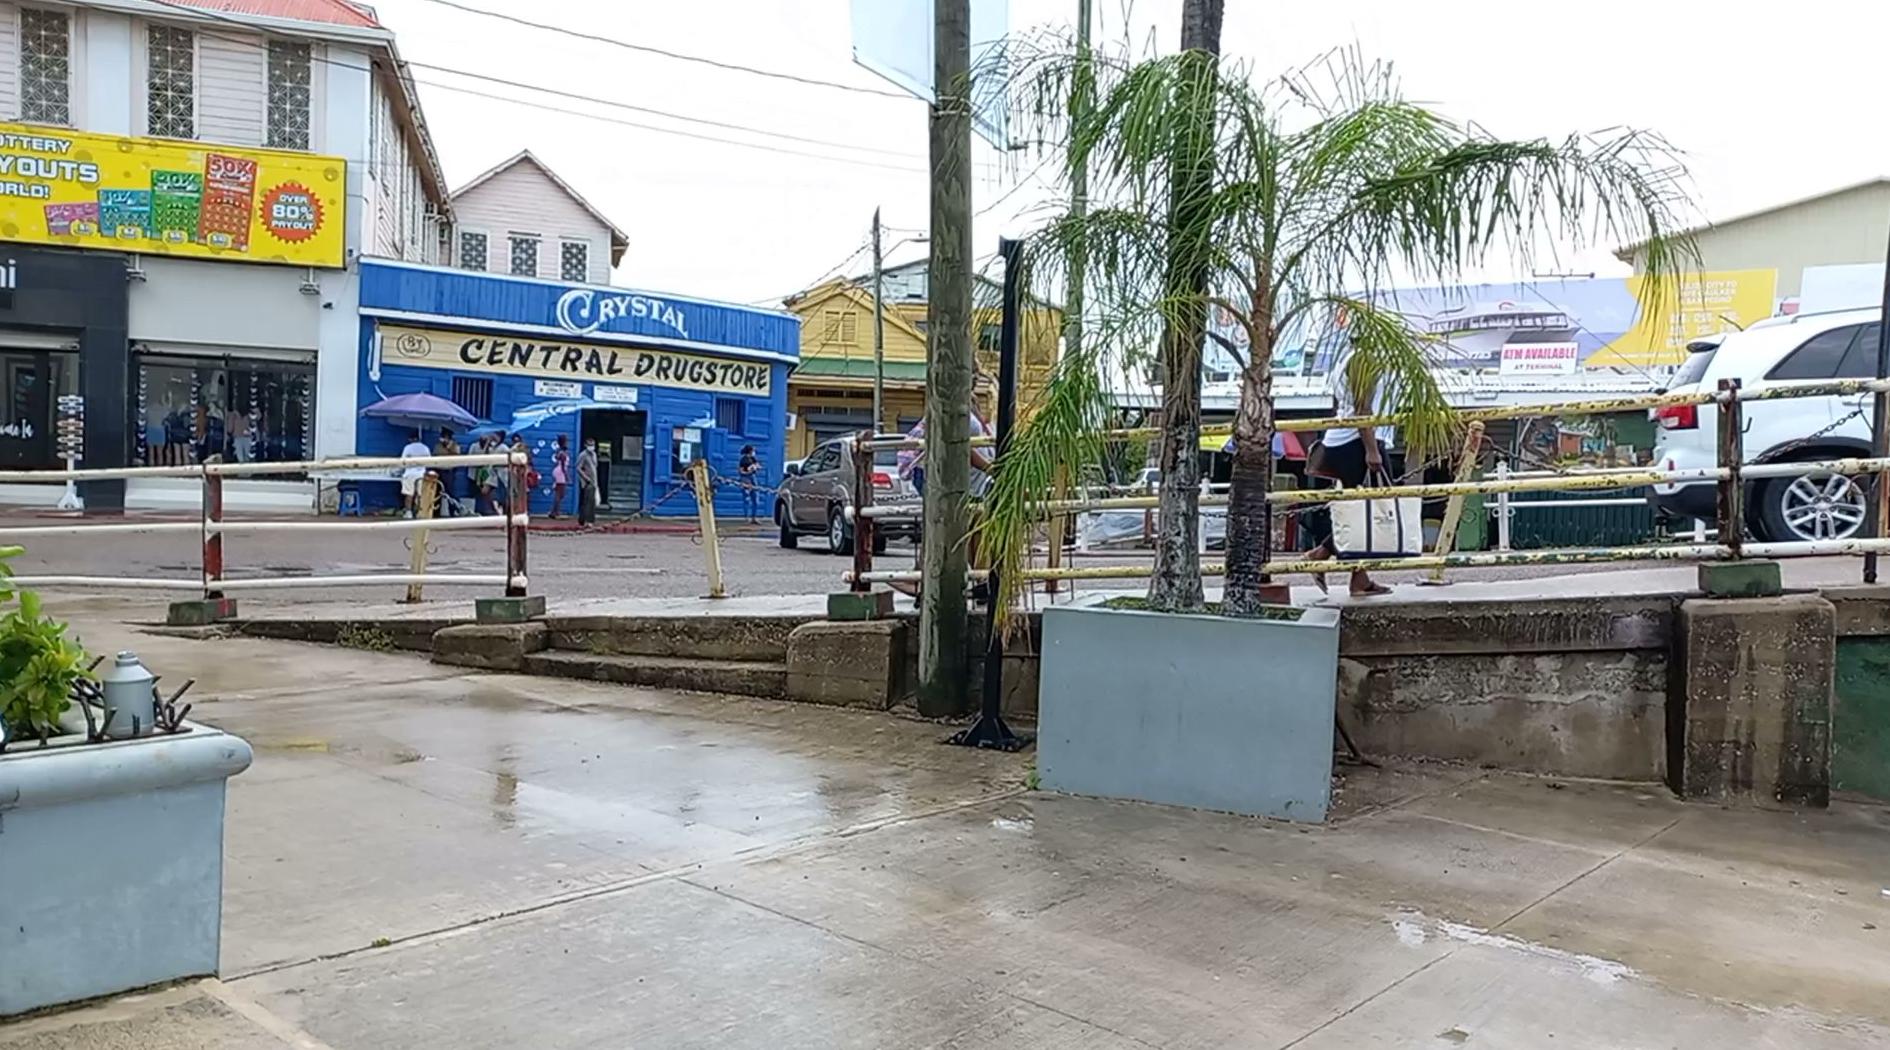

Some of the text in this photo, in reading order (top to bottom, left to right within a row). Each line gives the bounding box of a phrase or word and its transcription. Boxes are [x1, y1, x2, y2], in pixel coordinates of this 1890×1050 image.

[279, 194, 308, 203] OVER
[272, 204, 314, 220] 80%
[271, 220, 315, 230] PAYOUT
[555, 289, 690, 336] CRYSTAL
[1503, 347, 1576, 360] ATM AVAILABLE
[459, 338, 769, 389] CENTRAL DRUGSTORE
